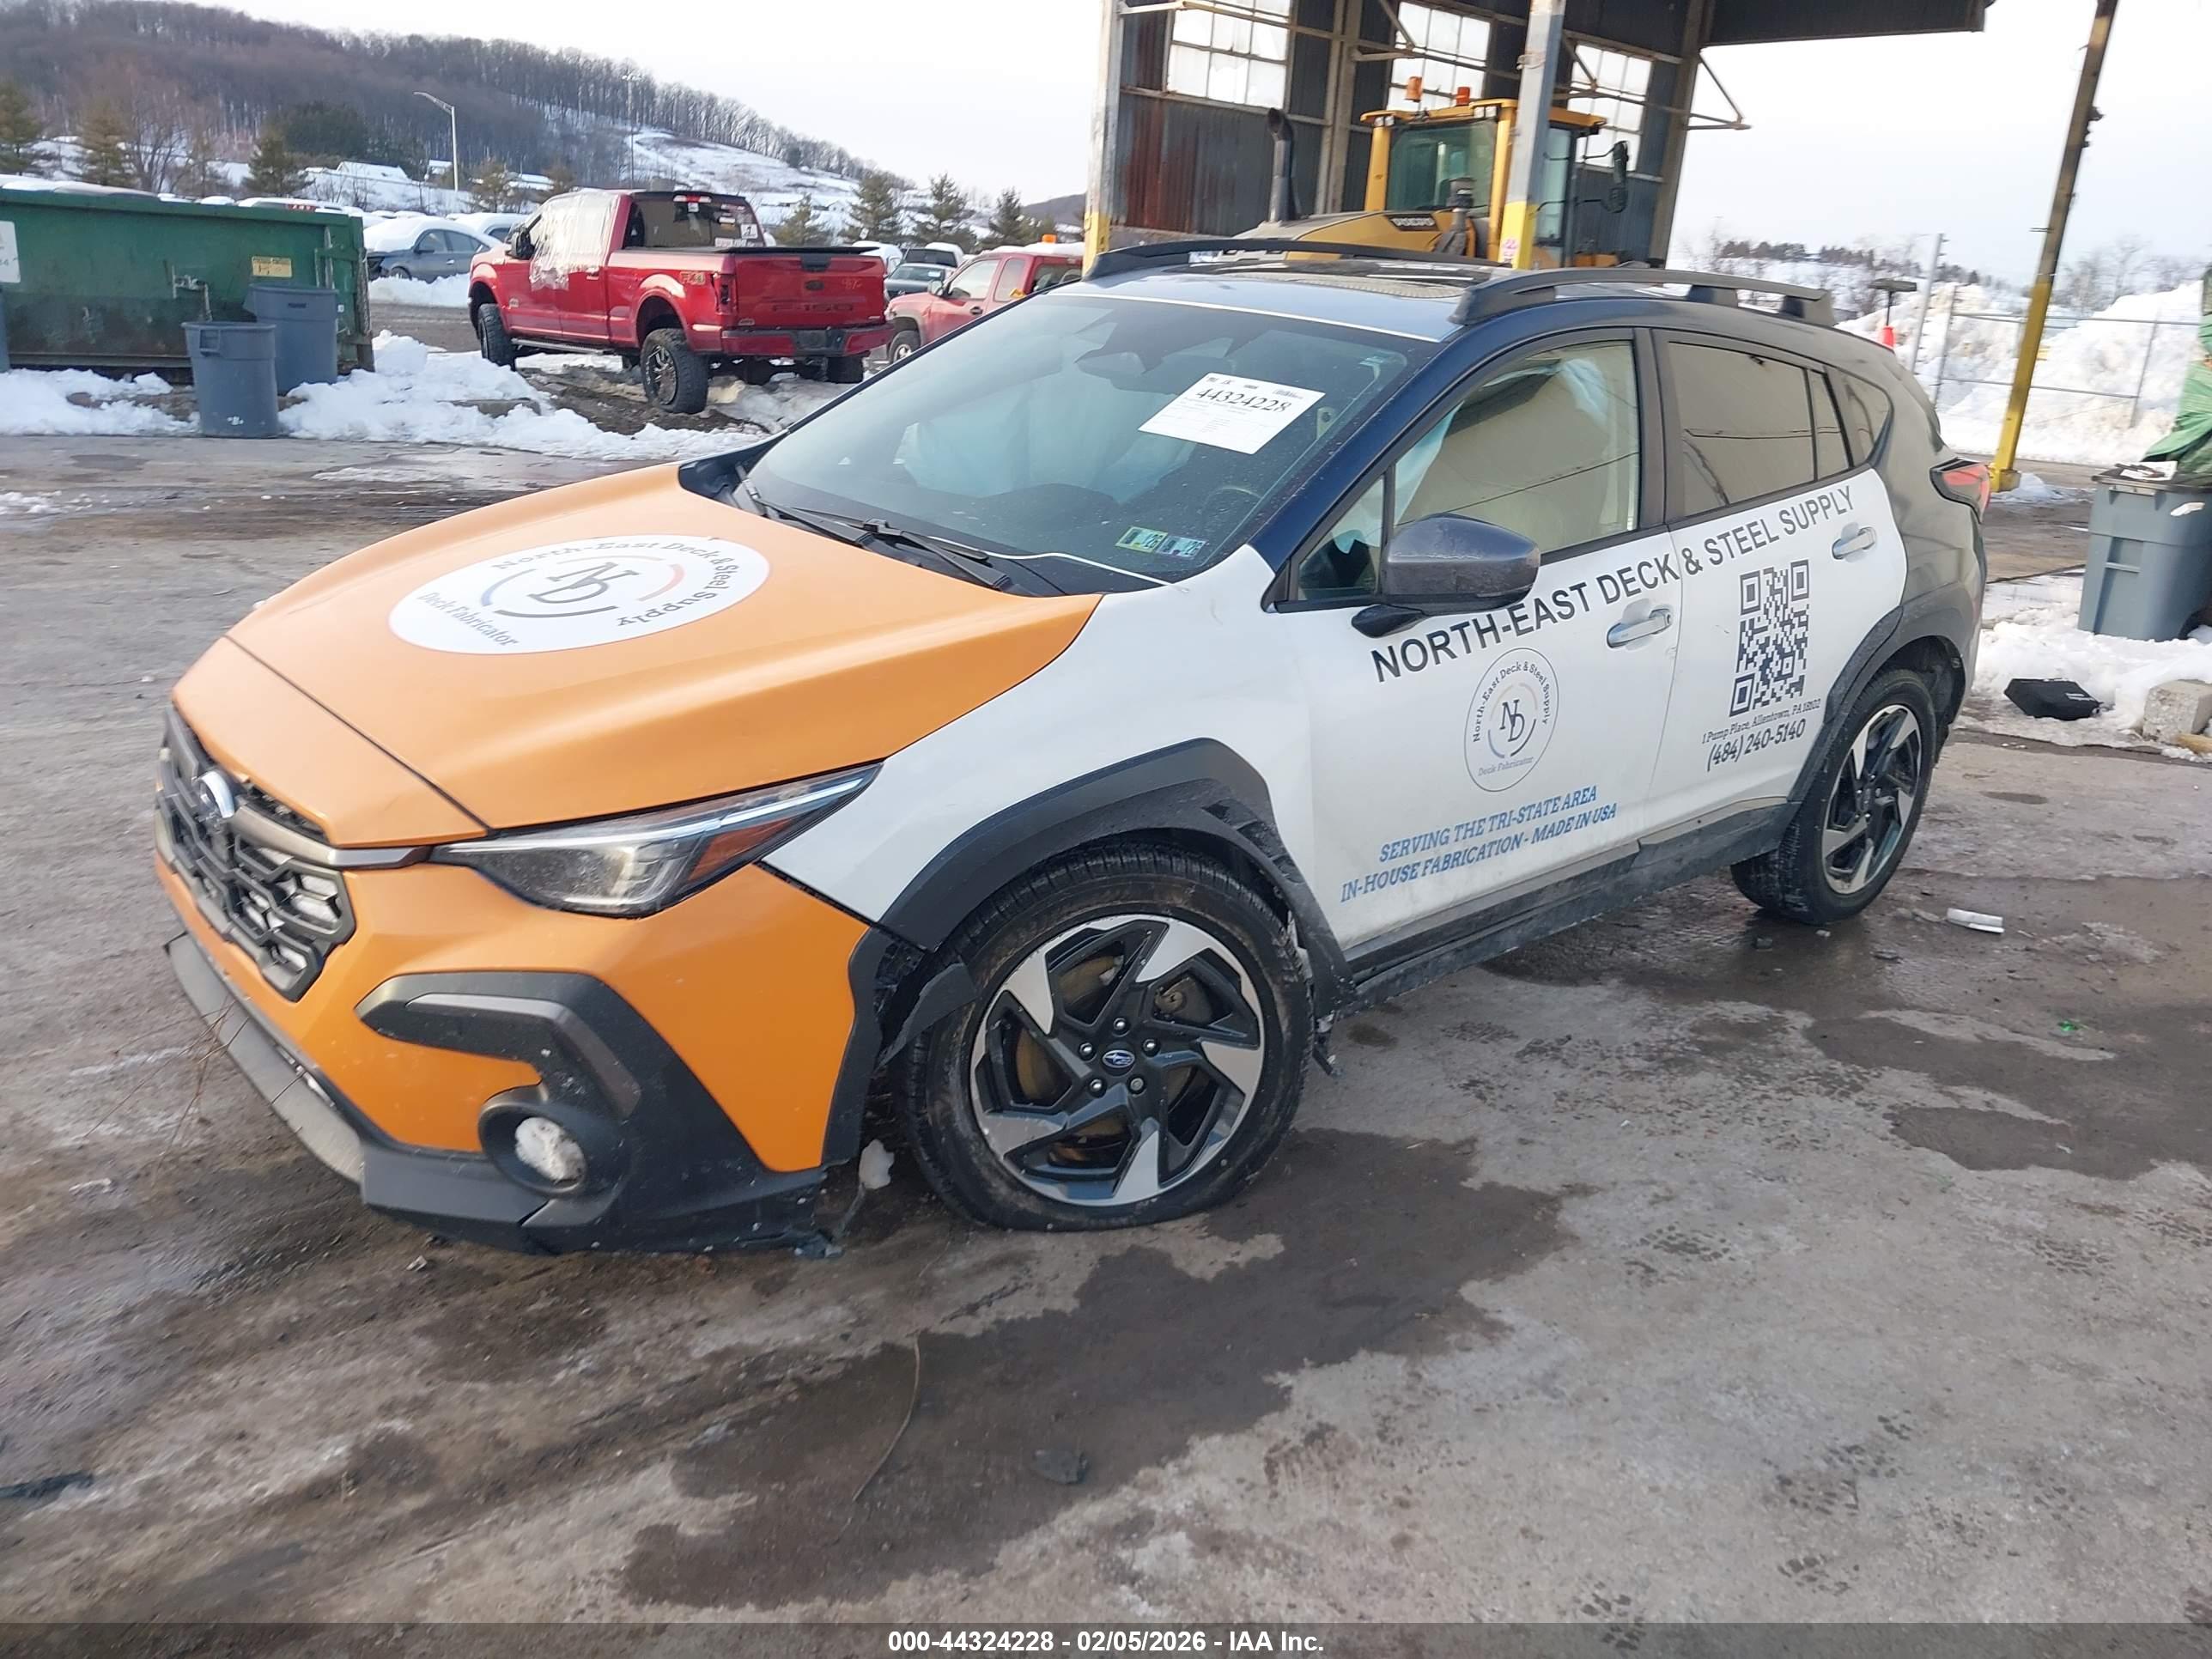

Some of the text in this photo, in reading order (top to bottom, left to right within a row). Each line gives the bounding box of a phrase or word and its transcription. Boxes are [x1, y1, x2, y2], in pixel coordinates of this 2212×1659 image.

[1195, 387, 1292, 413] 44324228
[416, 592, 520, 647] Deck Fabricator
[491, 542, 740, 627] North-East Deck & Steel Supply
[1370, 485, 1855, 683] NORTH-EAST DECK & STEEL SUPPLY
[1473, 661, 1552, 743] North-East Deck & Steel Supply
[1707, 718, 1806, 772] (484) 240-5140
[1340, 863, 1420, 902] IN-HOUSE
[1420, 831, 1525, 878] FABRICATION
[1530, 817, 1575, 845] MADE
[1573, 813, 1593, 830] IN
[1591, 803, 1618, 824] USA
[1379, 785, 1597, 863] SERVING THE TRI-STATE AREA
